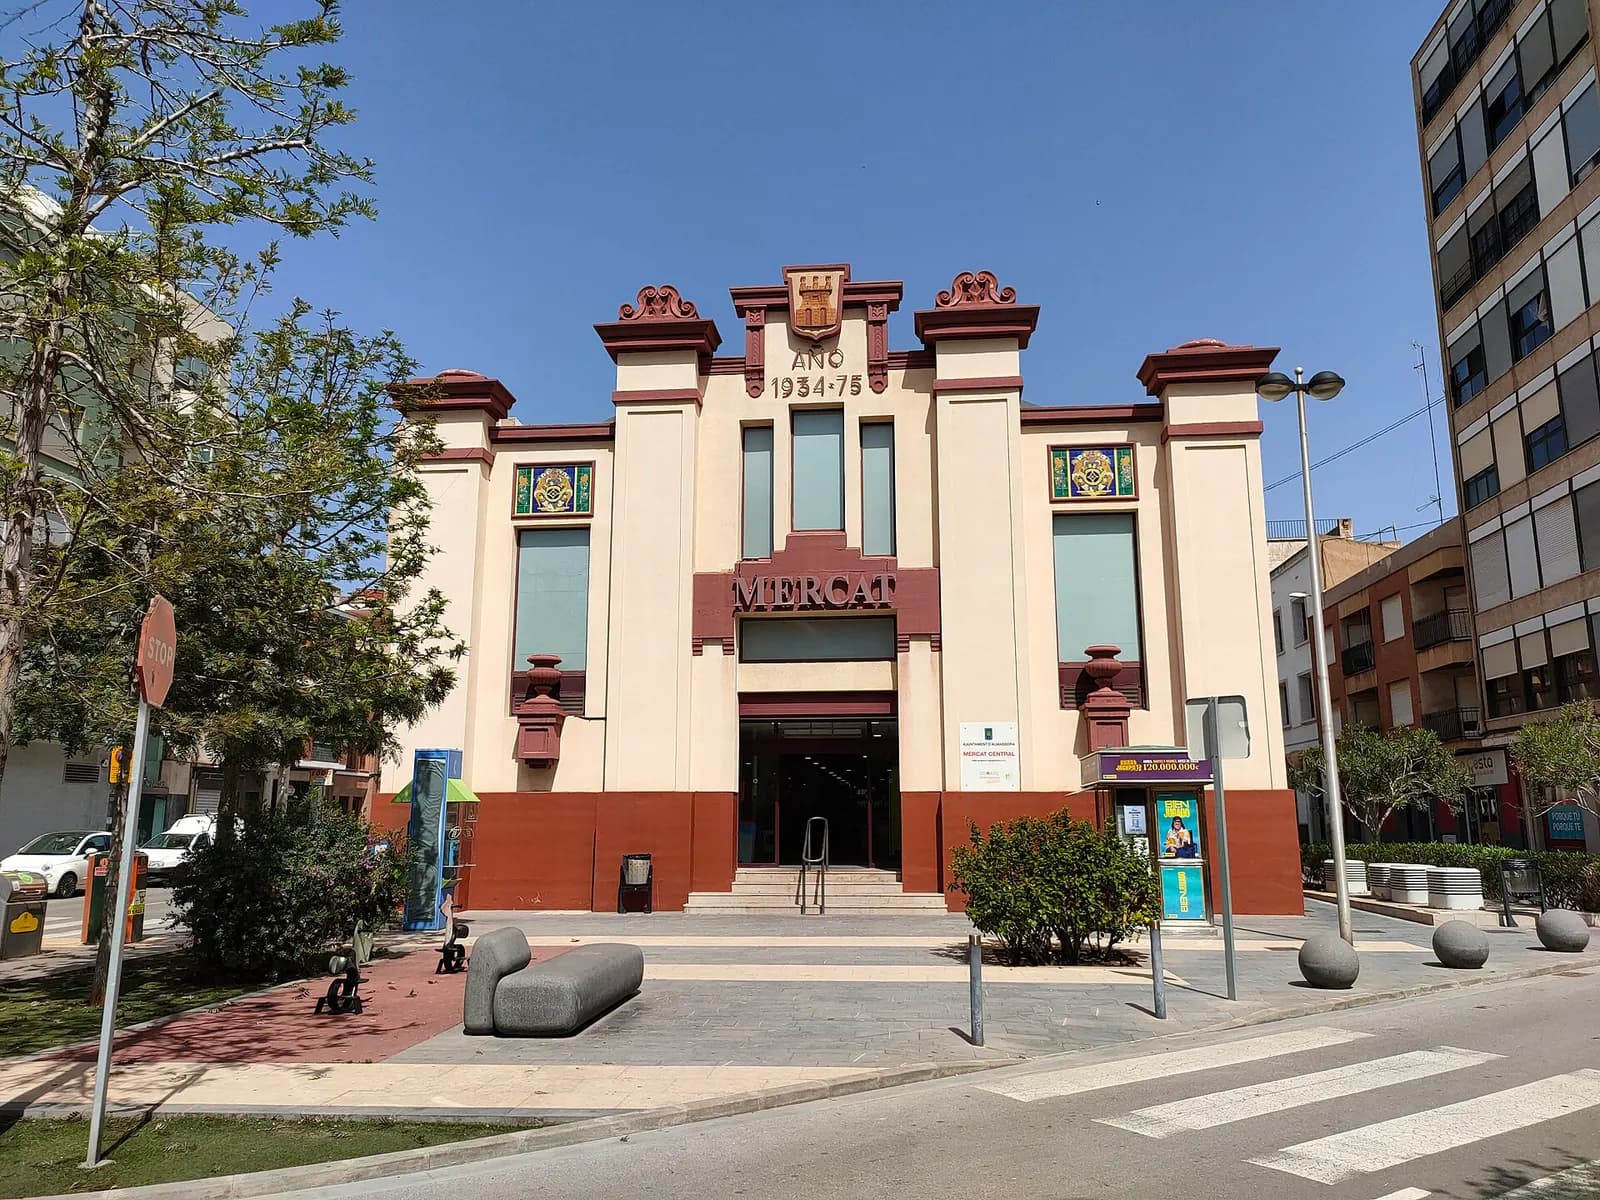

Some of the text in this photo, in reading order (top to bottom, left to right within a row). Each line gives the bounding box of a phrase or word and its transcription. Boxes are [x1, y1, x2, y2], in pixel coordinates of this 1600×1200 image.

[733, 574, 897, 607] MERCAT
[148, 636, 174, 668] STOP
[1164, 800, 1190, 809] BIEN
[1551, 812, 1573, 821] PORQUE
[1552, 822, 1582, 831] PORQUE TE
